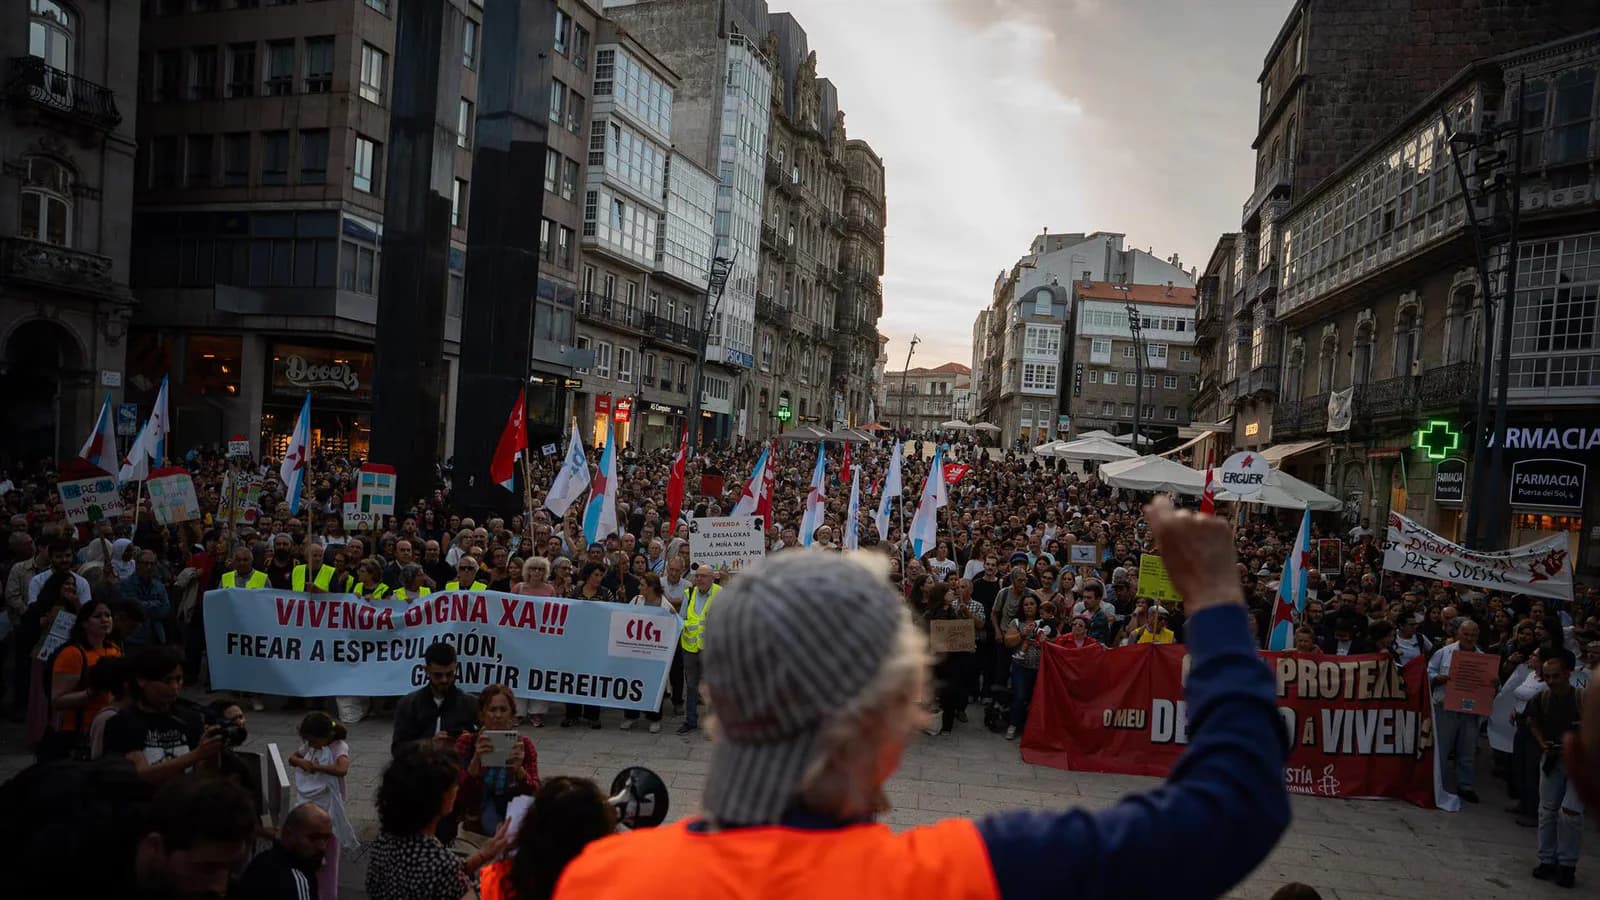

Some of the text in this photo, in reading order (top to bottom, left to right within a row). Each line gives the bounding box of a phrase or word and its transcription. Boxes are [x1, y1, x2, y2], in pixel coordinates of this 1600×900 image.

[285, 354, 359, 391] Dooers
[1075, 363, 1083, 393] HOTEL
[1485, 427, 1600, 450] RMACIA
[1223, 471, 1263, 484] ERGUER
[1437, 472, 1463, 482] FARMACIA
[1515, 473, 1579, 486] FARMACIA
[1518, 488, 1541, 496] Puerta
[1542, 488, 1553, 496] del
[712, 531, 751, 539] DESALOXAS
[1401, 551, 1442, 575] PAZ
[275, 594, 568, 635] VIVENDA DIGNA XA!!!
[626, 619, 661, 642] CIG
[226, 633, 301, 660] FREAR
[310, 638, 326, 661] A
[528, 667, 644, 702] DEREITOS
[1275, 657, 1406, 700] PROTEXE
[1103, 708, 1145, 729] O MEU
[1302, 716, 1315, 745] Á
